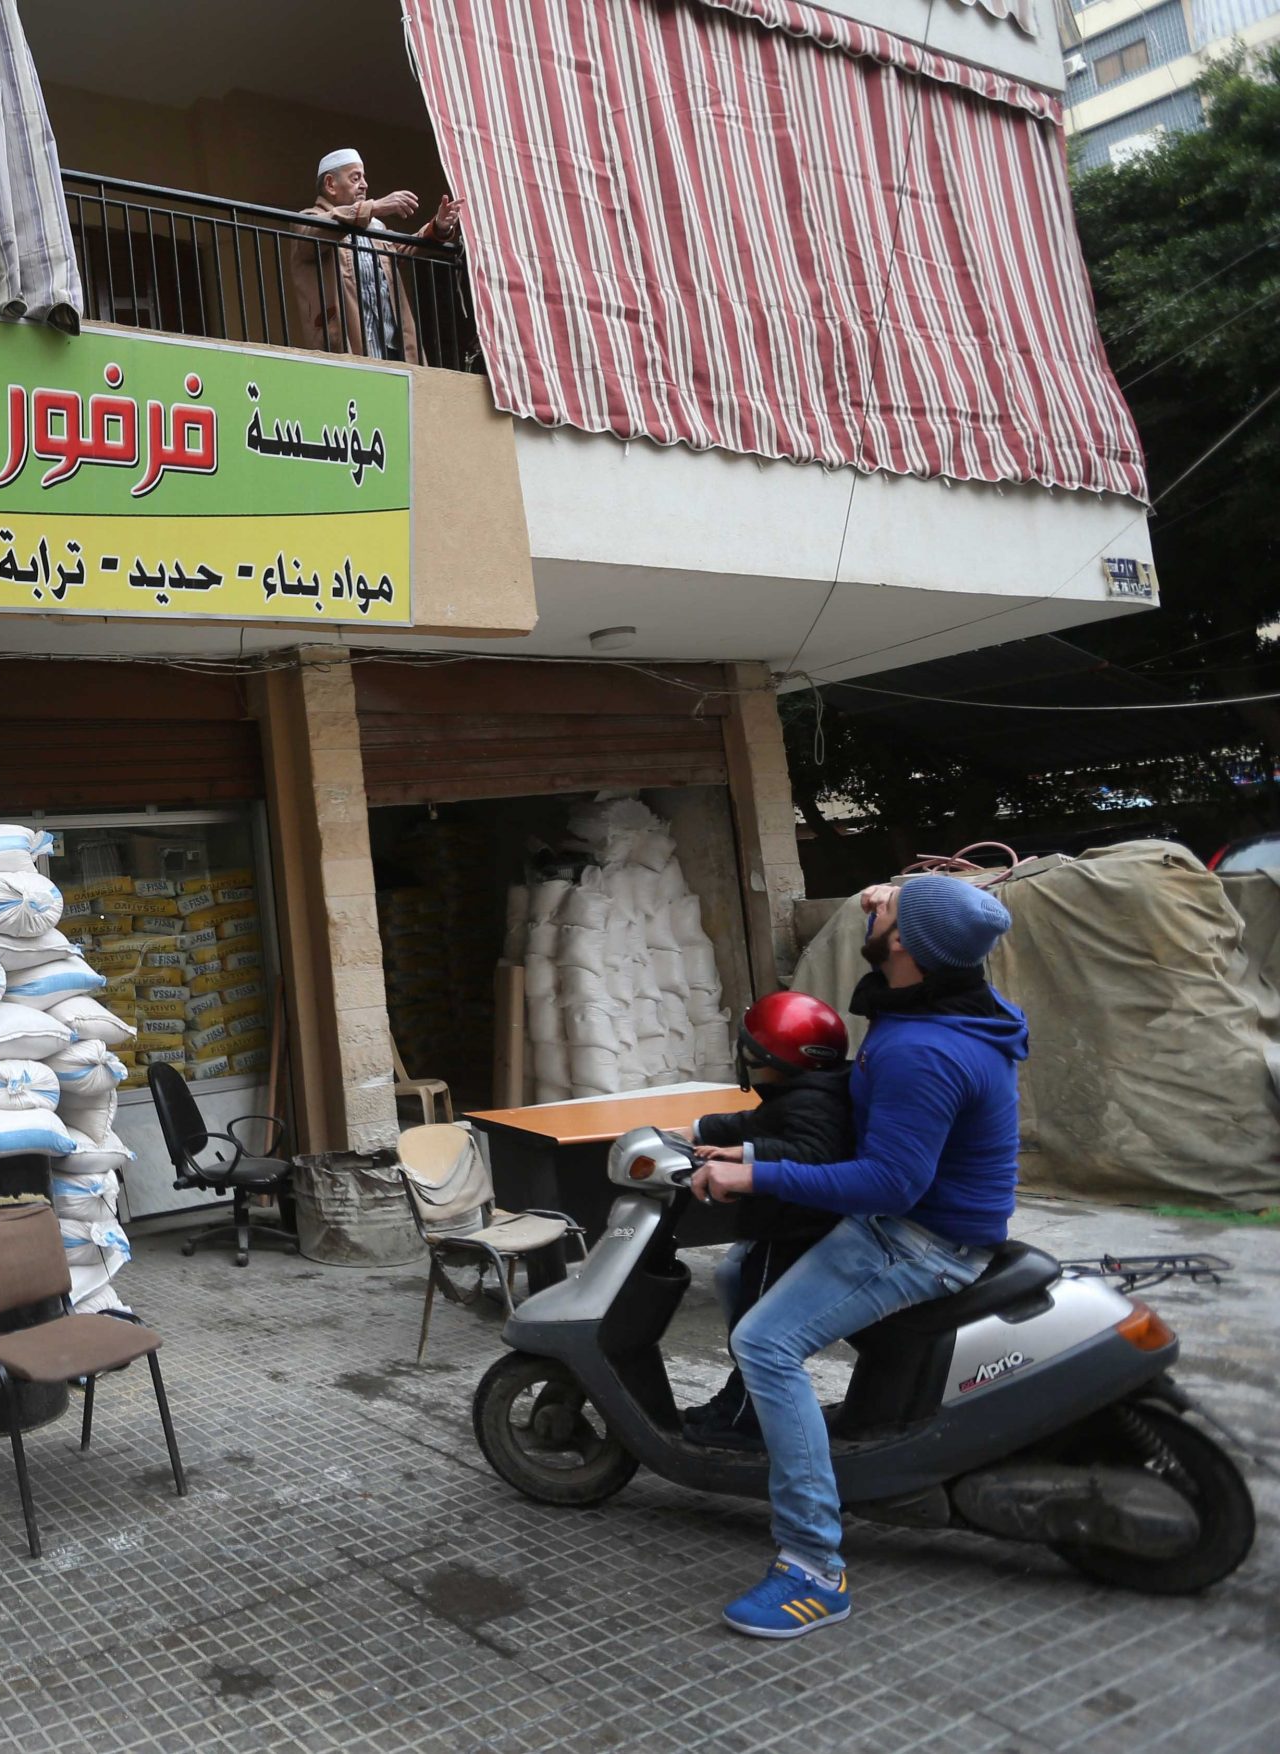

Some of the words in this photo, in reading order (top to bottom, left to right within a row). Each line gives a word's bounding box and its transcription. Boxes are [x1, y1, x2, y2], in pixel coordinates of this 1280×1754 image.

[245, 384, 387, 488] مؤسسة
[128, 556, 223, 605] حديد
[261, 552, 322, 612] بناء
[331, 557, 394, 614] مواد
[113, 902, 167, 913] FISSATIVO
[189, 894, 210, 909] FISSA
[159, 954, 180, 965] FISSA
[152, 989, 177, 999] FISSA
[145, 1022, 170, 1032] FISSA
[975, 1351, 1023, 1384] Aprio
